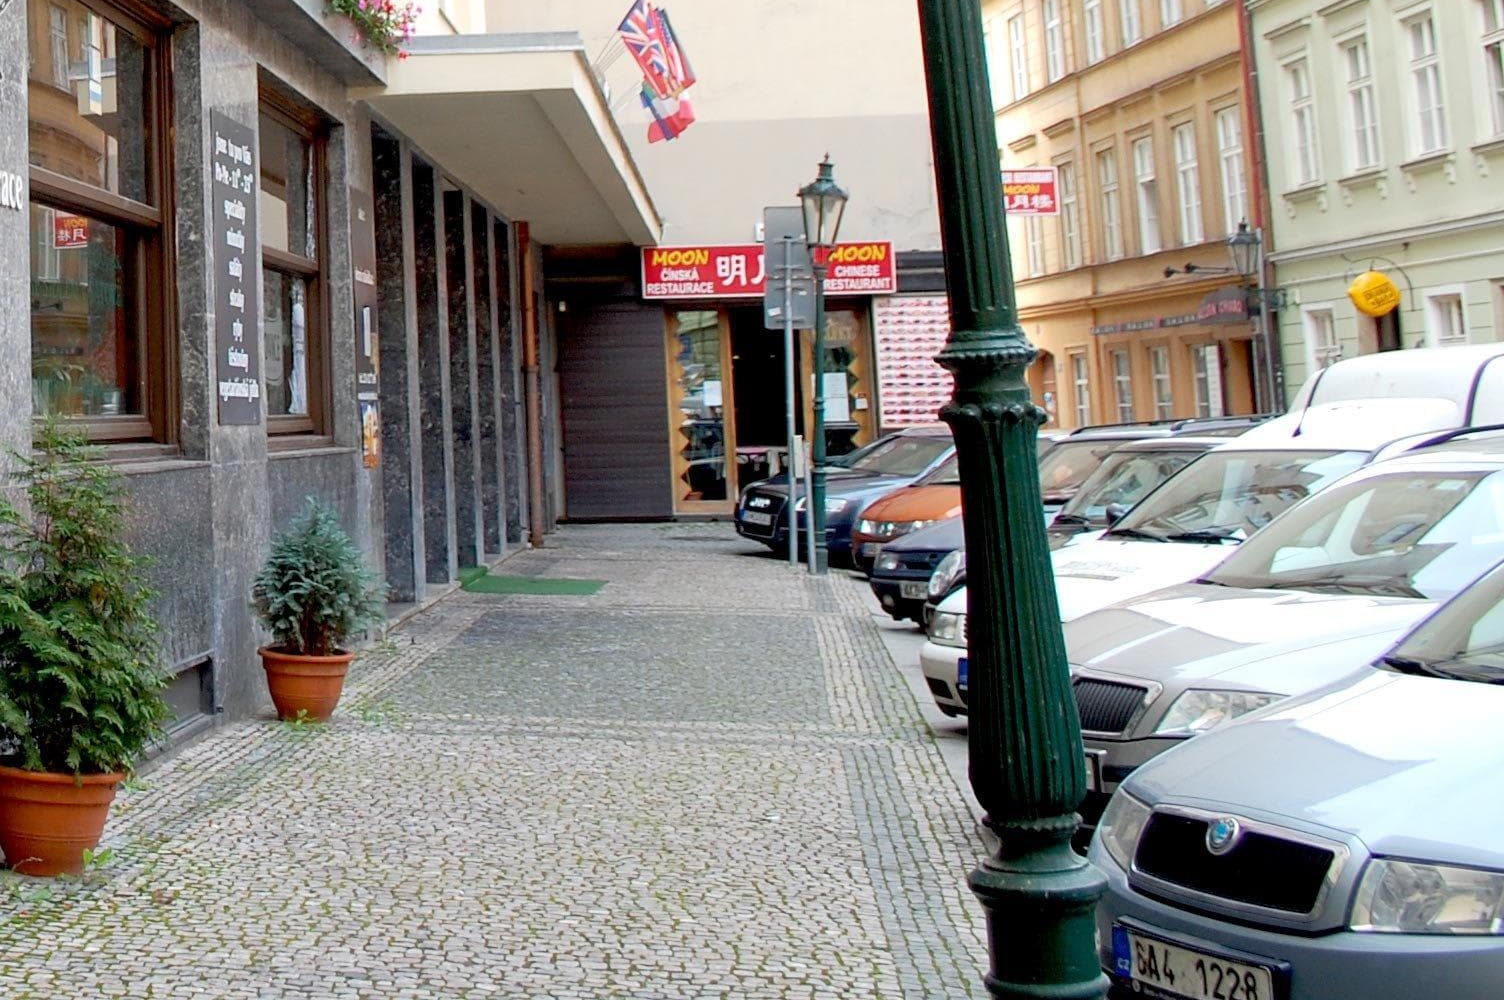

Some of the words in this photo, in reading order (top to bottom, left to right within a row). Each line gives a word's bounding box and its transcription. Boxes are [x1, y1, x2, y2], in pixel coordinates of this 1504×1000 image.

[652, 249, 709, 266] MOON
[828, 245, 886, 263] MOON
[660, 267, 700, 282] ČÍNSKÁ
[716, 254, 765, 286] 明
[834, 264, 880, 277] CHINESE
[647, 282, 714, 295] RESTAURACE
[823, 277, 891, 290] RESTAURANT
[1195, 958, 1258, 1000] 1228
